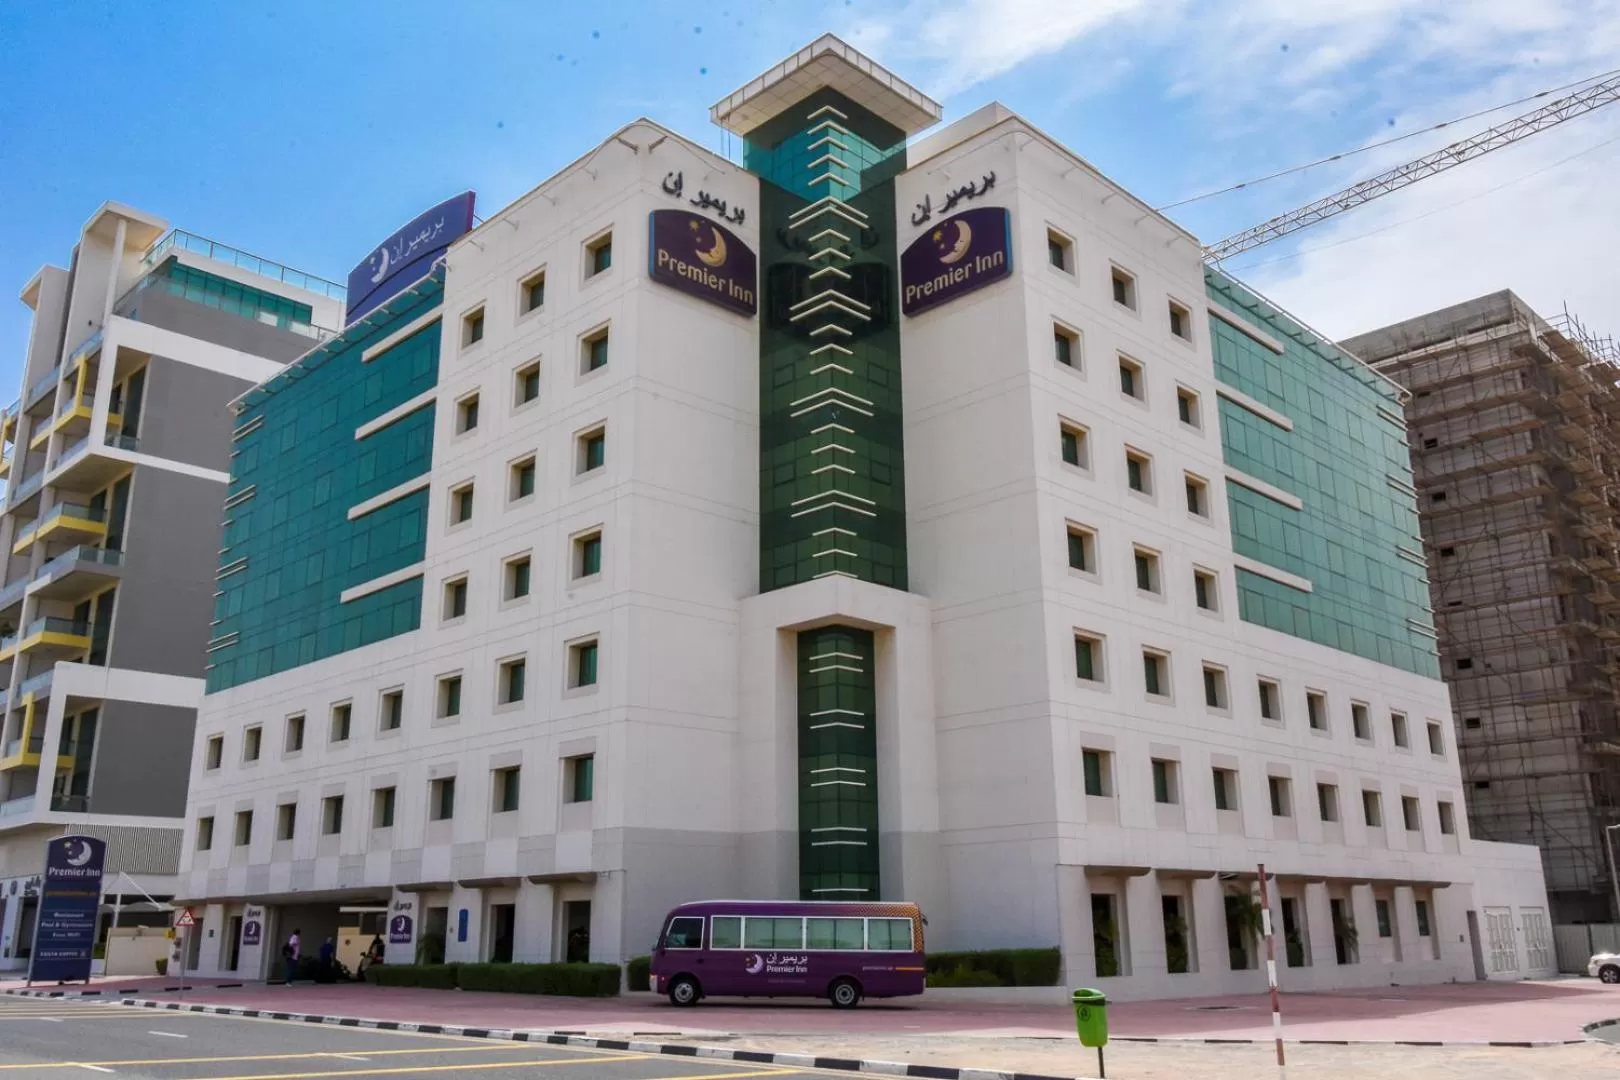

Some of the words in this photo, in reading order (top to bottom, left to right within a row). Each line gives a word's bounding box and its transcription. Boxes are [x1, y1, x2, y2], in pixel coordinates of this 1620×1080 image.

[657, 249, 726, 292] Premier
[729, 278, 753, 305] Inn
[906, 263, 972, 304] Premier
[976, 250, 1004, 273] Inn
[48, 866, 86, 876] Premier
[86, 867, 100, 876] Inn
[766, 965, 795, 973] Premier
[796, 965, 808, 973] Inn
